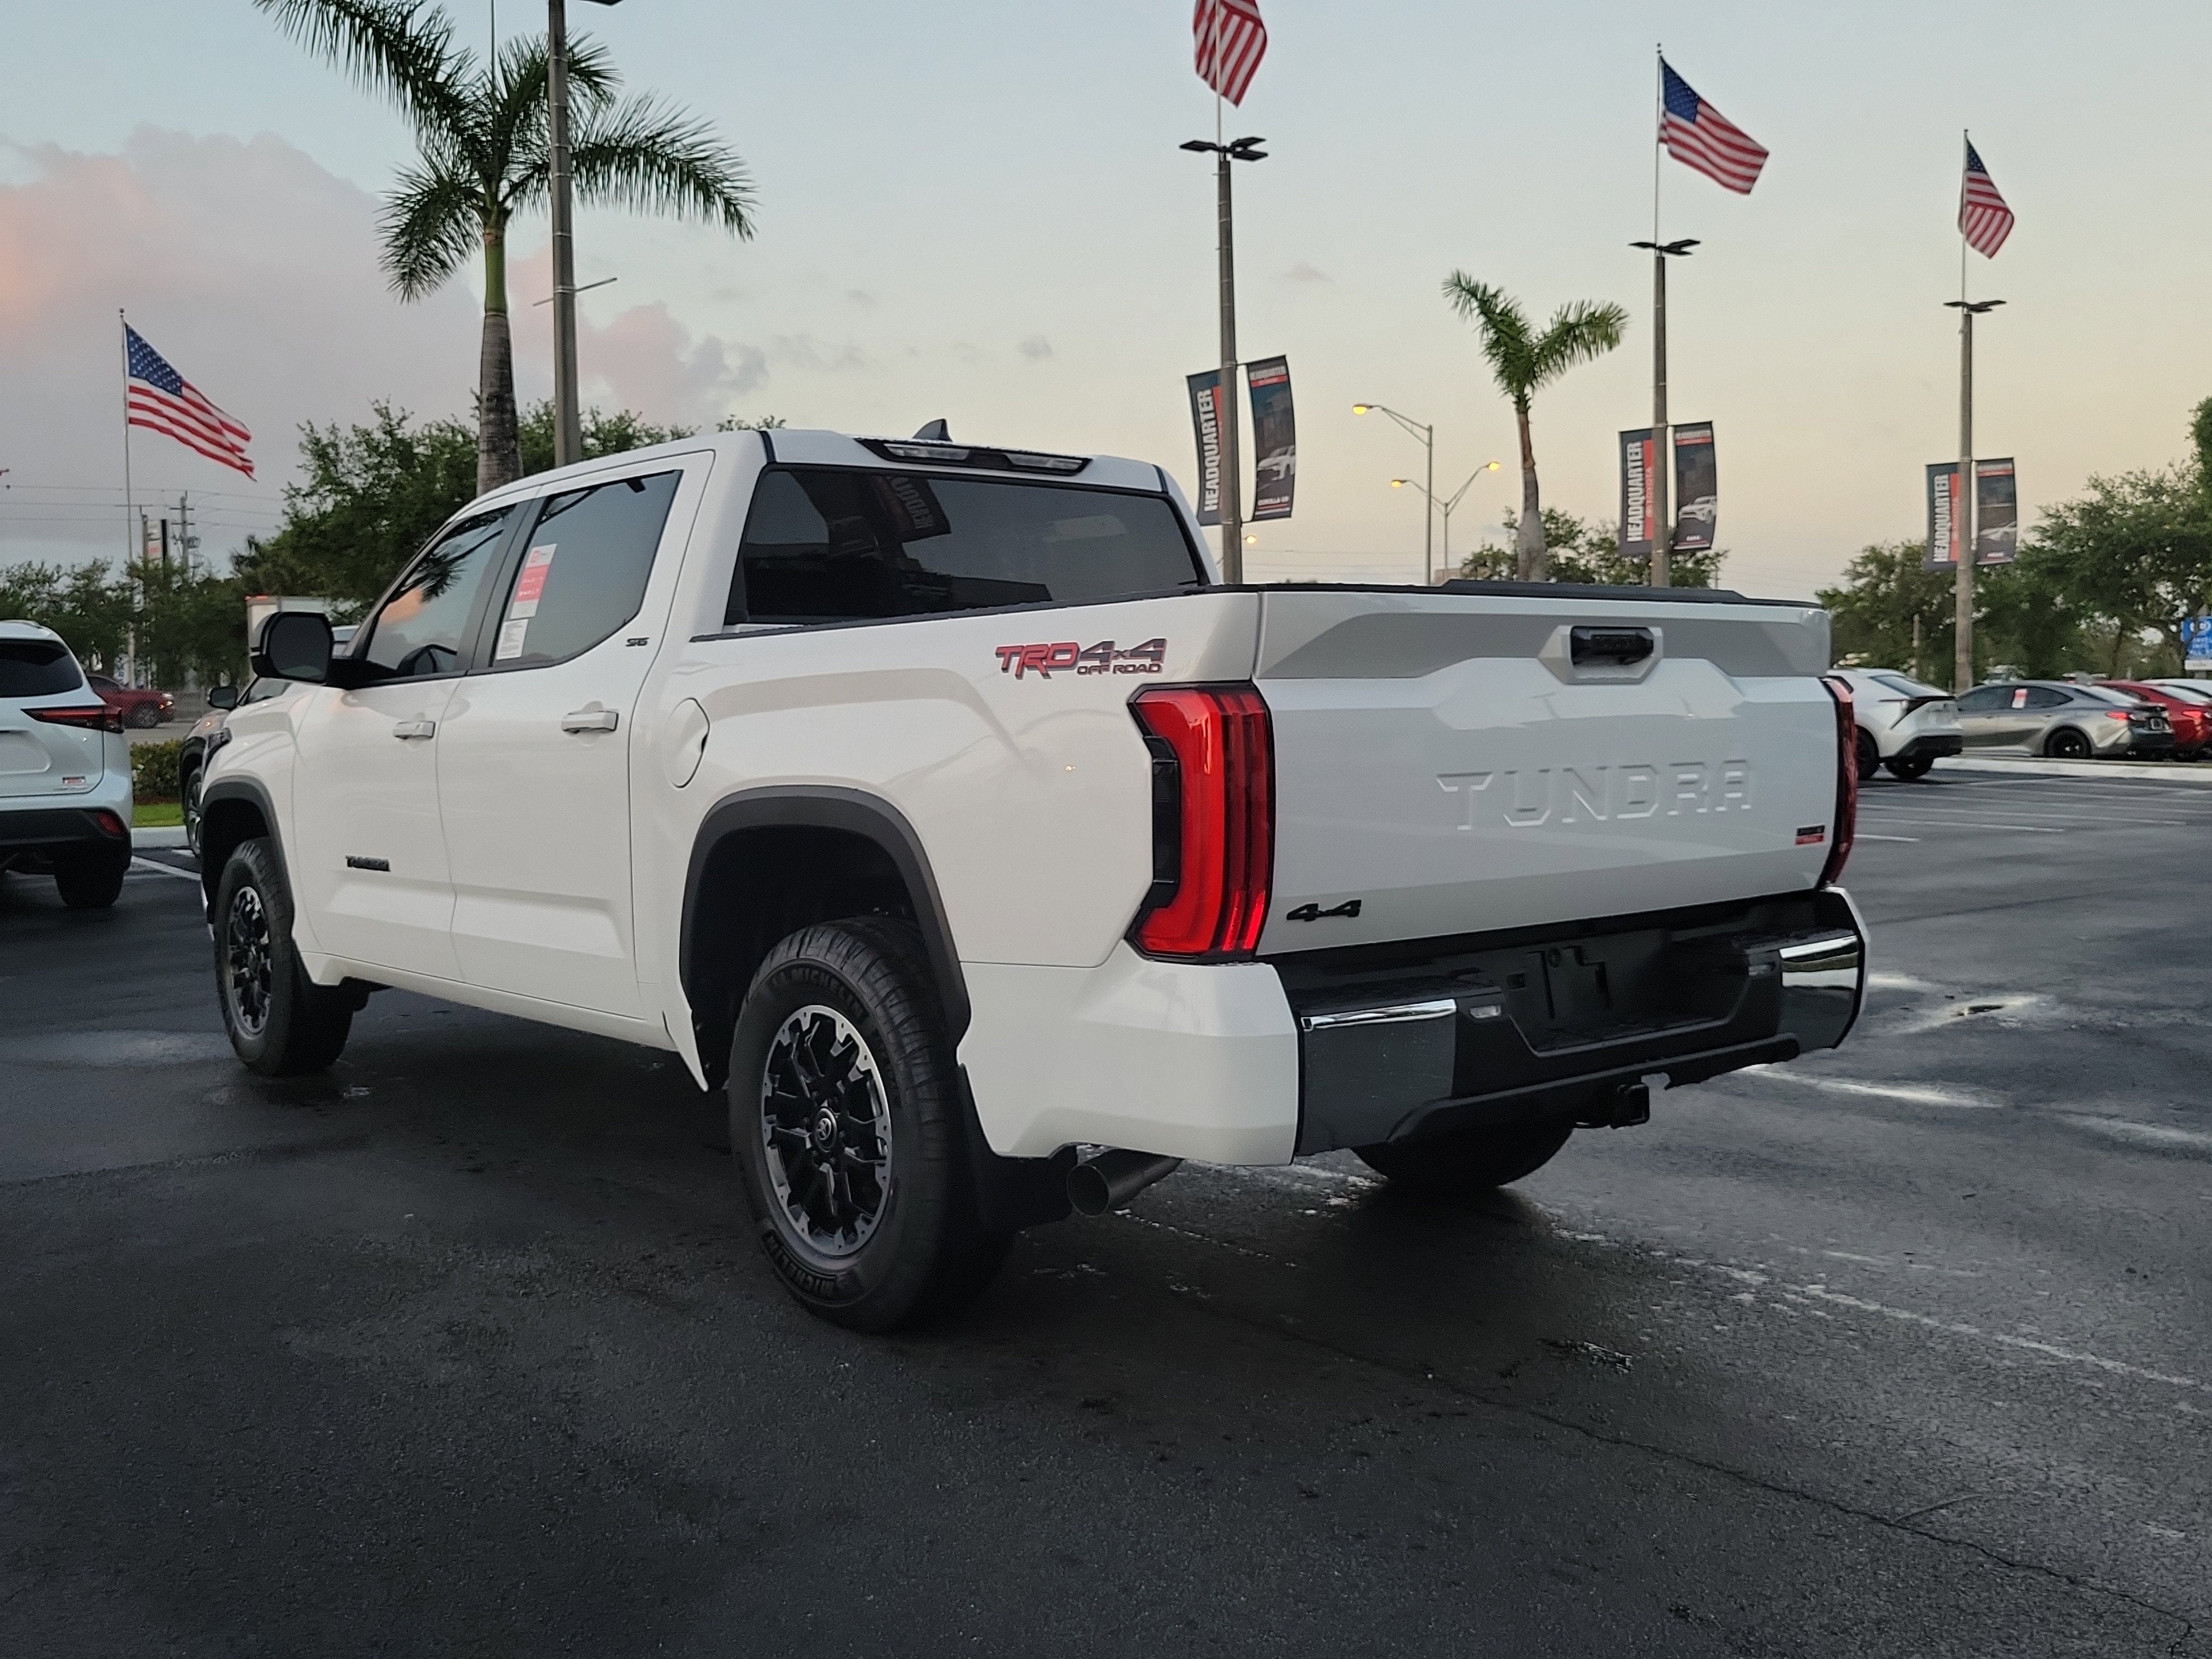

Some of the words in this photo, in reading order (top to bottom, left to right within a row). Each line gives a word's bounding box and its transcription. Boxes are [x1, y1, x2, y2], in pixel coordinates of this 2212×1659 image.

[1197, 388, 1220, 512] HEADQUARTER
[1627, 441, 1645, 542] HEADQUARTER
[1933, 474, 1950, 562] HEADQUARTER
[995, 641, 1080, 680] TRD
[1076, 665, 1110, 675] OFF
[1113, 663, 1163, 674] ROAD
[1436, 759, 1752, 831] TUNDRA
